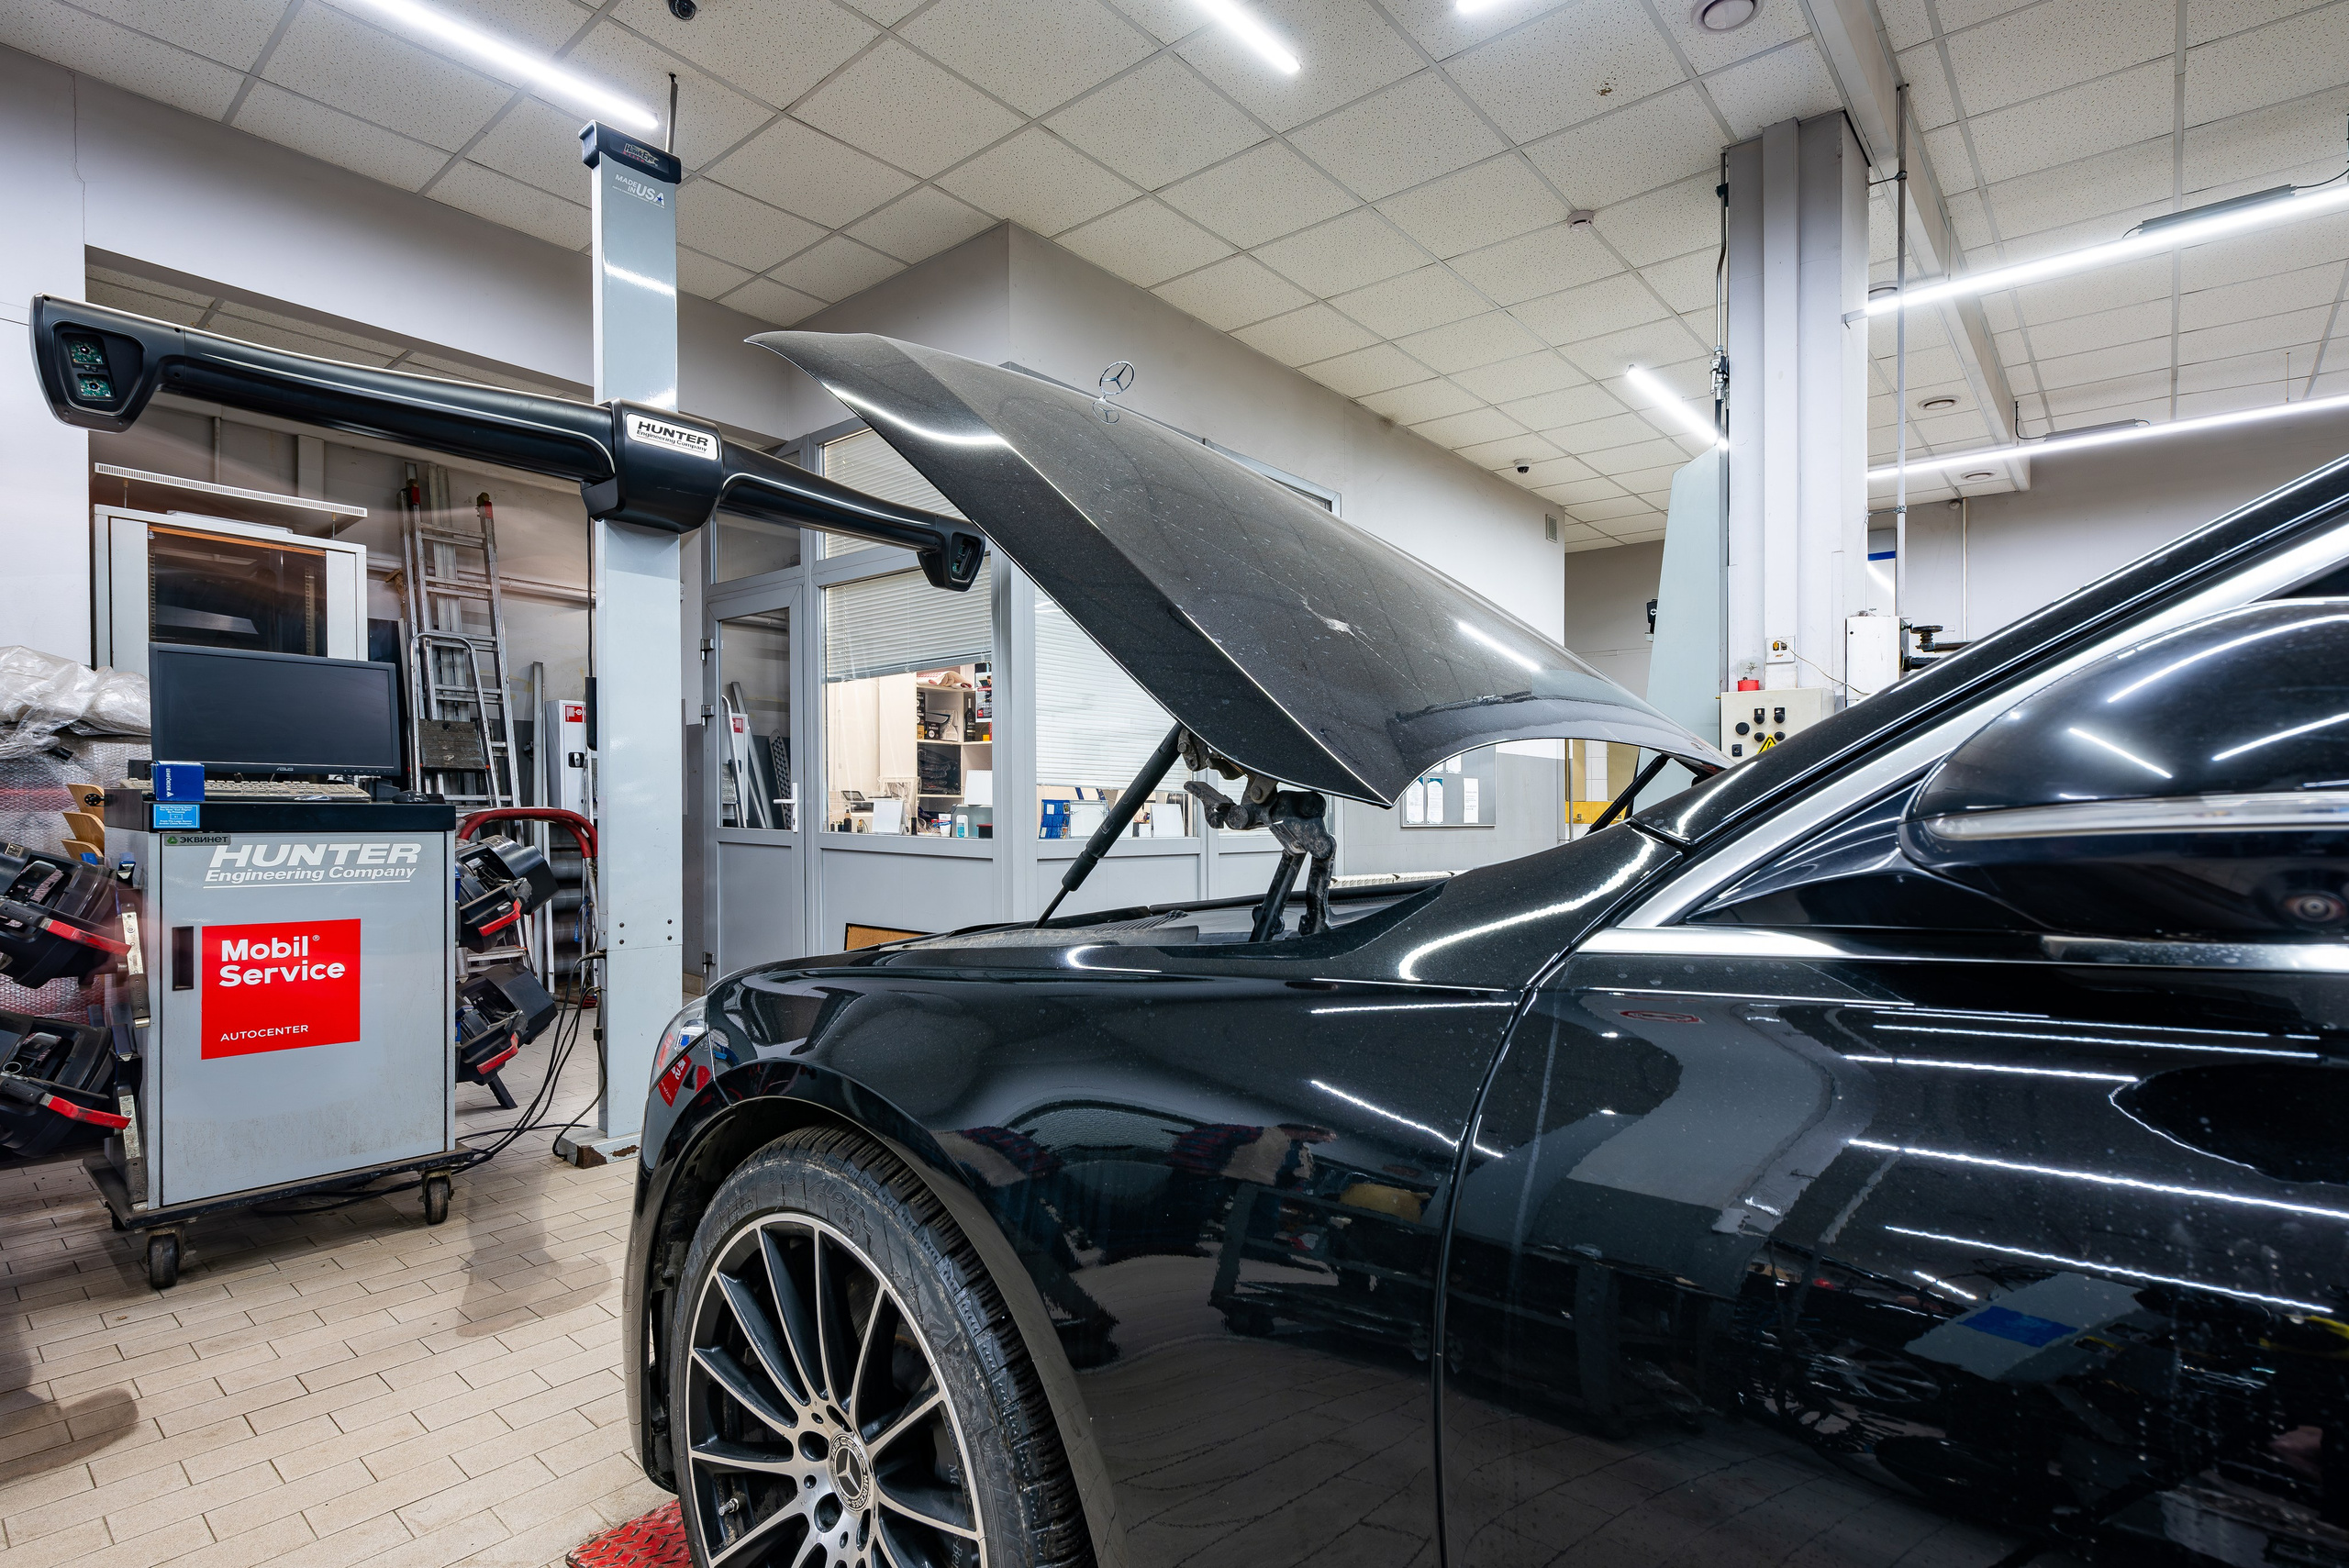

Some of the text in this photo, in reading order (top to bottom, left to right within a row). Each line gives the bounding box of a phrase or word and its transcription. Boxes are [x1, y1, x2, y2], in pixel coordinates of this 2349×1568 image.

[615, 174, 639, 187] MADE
[628, 185, 637, 194] IN
[636, 183, 665, 206] USA
[636, 429, 707, 452] Engineering Company
[638, 420, 708, 446] HUNTER
[209, 842, 421, 868] HUNTER
[205, 865, 417, 884] Engineering Company
[218, 959, 346, 987] Service
[220, 1024, 308, 1042] AUTOCENTER
[852, 1474, 869, 1507] MERCEDES
